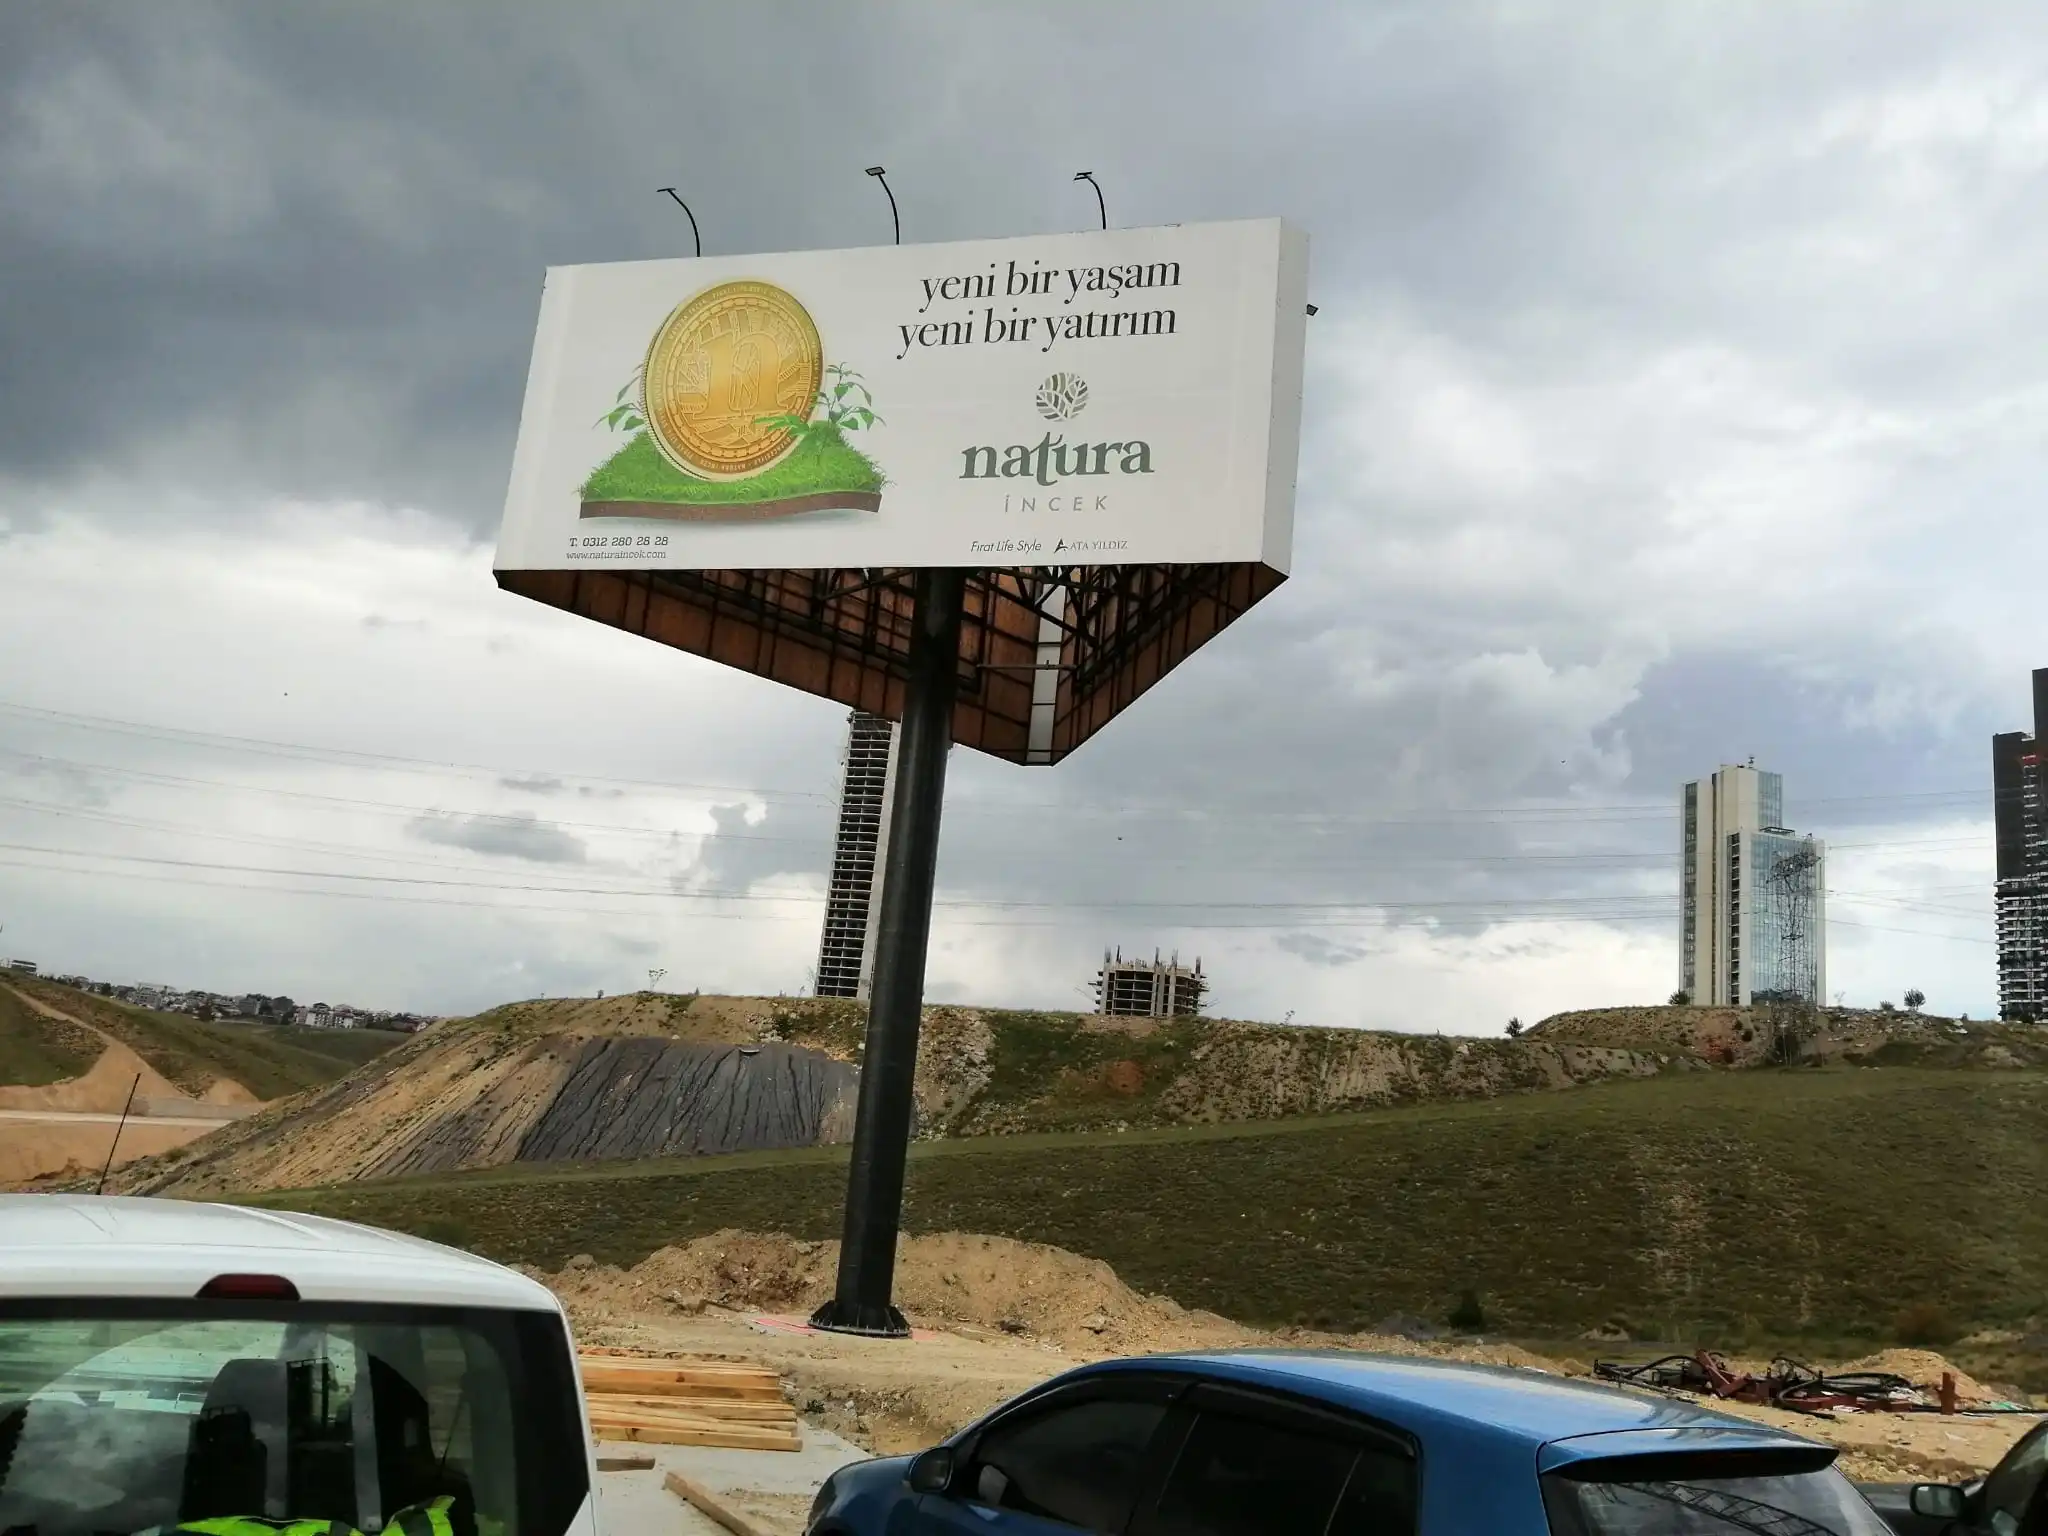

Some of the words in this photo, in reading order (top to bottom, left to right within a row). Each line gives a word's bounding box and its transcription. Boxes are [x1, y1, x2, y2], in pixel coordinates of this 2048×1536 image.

[918, 263, 996, 313] yeni
[1006, 260, 1059, 296] bir
[1063, 261, 1182, 305] yaşam
[896, 310, 974, 360] yeni
[983, 307, 1037, 344] bir
[1041, 308, 1177, 353] yatırım
[958, 431, 1155, 487] natura
[1004, 494, 1109, 513] İNCEK
[569, 537, 578, 547] T.
[582, 537, 608, 547] 0312
[636, 536, 650, 546] 28
[655, 536, 669, 546] 28
[996, 539, 1014, 552] Life
[1017, 538, 1042, 554] Style
[1070, 541, 1089, 550] ATA
